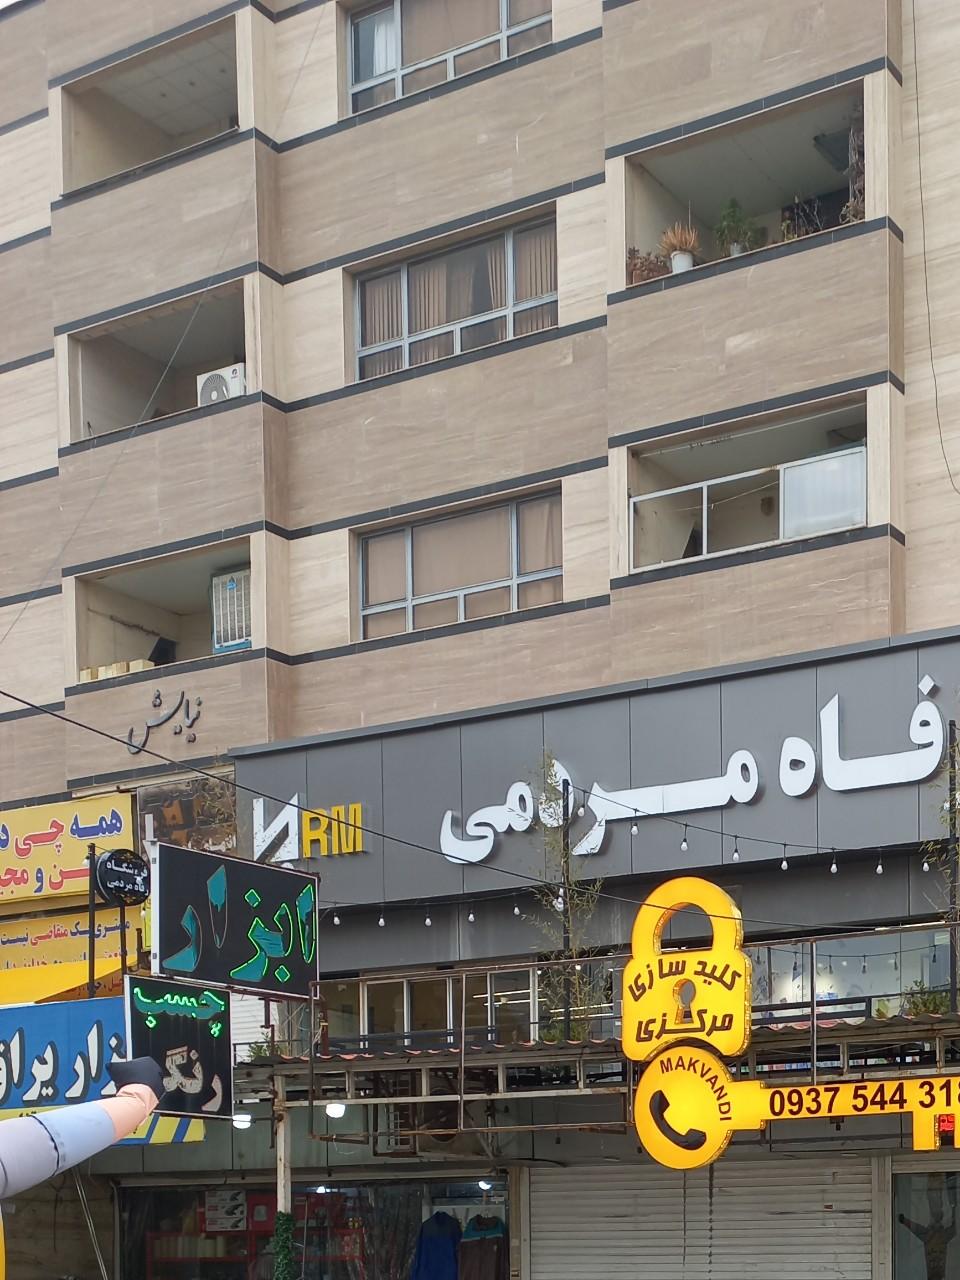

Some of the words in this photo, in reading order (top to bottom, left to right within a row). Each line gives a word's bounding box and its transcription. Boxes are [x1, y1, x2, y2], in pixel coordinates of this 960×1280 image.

[127, 689, 202, 755] نیایش
[70, 808, 122, 839] همه
[440, 749, 760, 864] مردمی
[15, 819, 65, 857] چی
[0, 928, 29, 946] نیست
[162, 864, 316, 983] ابزار
[628, 958, 687, 1002] سازی
[694, 960, 743, 992] کلید
[133, 986, 225, 1038] چسب
[635, 1008, 734, 1043] مرکزی
[659, 1055, 732, 1121] MAKVANDI
[769, 1087, 841, 1117] 0937
[852, 1082, 908, 1113] 544
